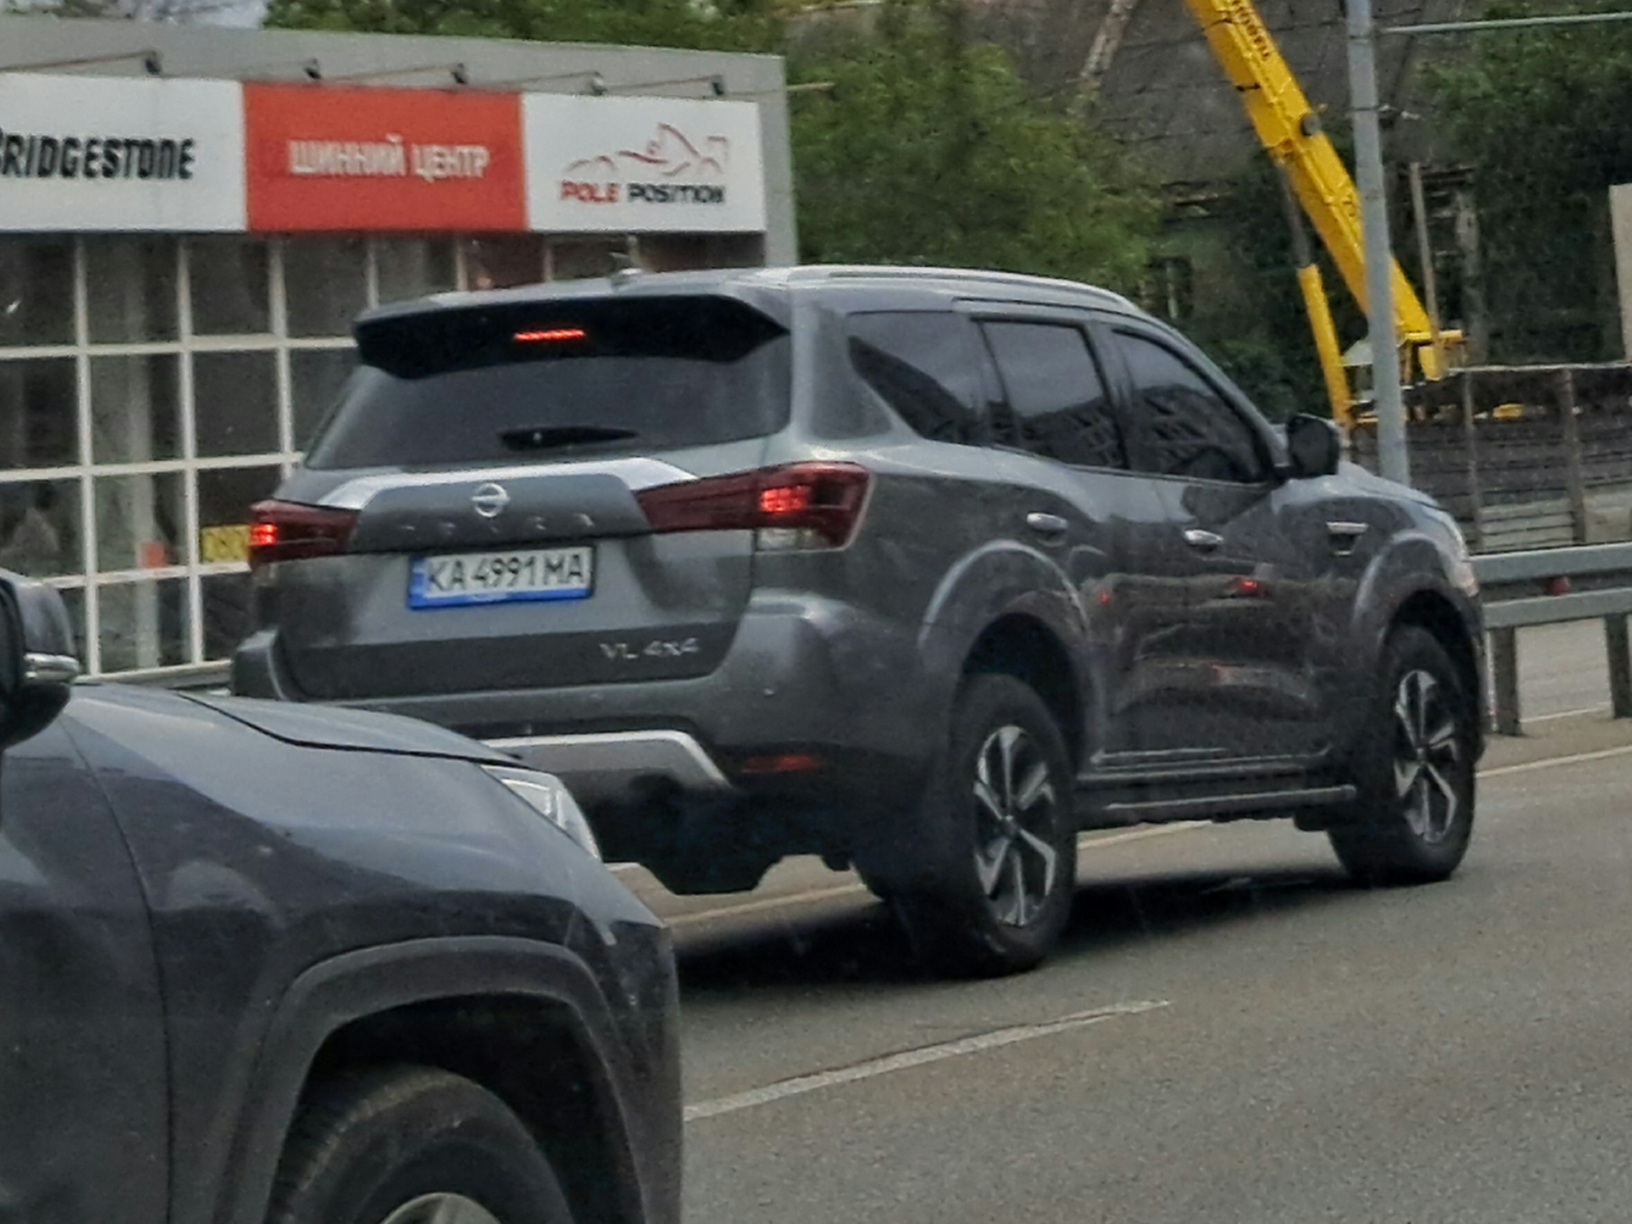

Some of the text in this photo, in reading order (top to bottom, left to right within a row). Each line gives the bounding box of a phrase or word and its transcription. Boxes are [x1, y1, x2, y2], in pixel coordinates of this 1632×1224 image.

[0, 128, 195, 179] RIDGESTONE
[288, 133, 490, 182] ШИННИЙ ЦЕНТР
[561, 180, 726, 204] POLE POSITION
[427, 559, 466, 592] KA
[471, 556, 537, 588] 4991
[599, 642, 639, 661] VL
